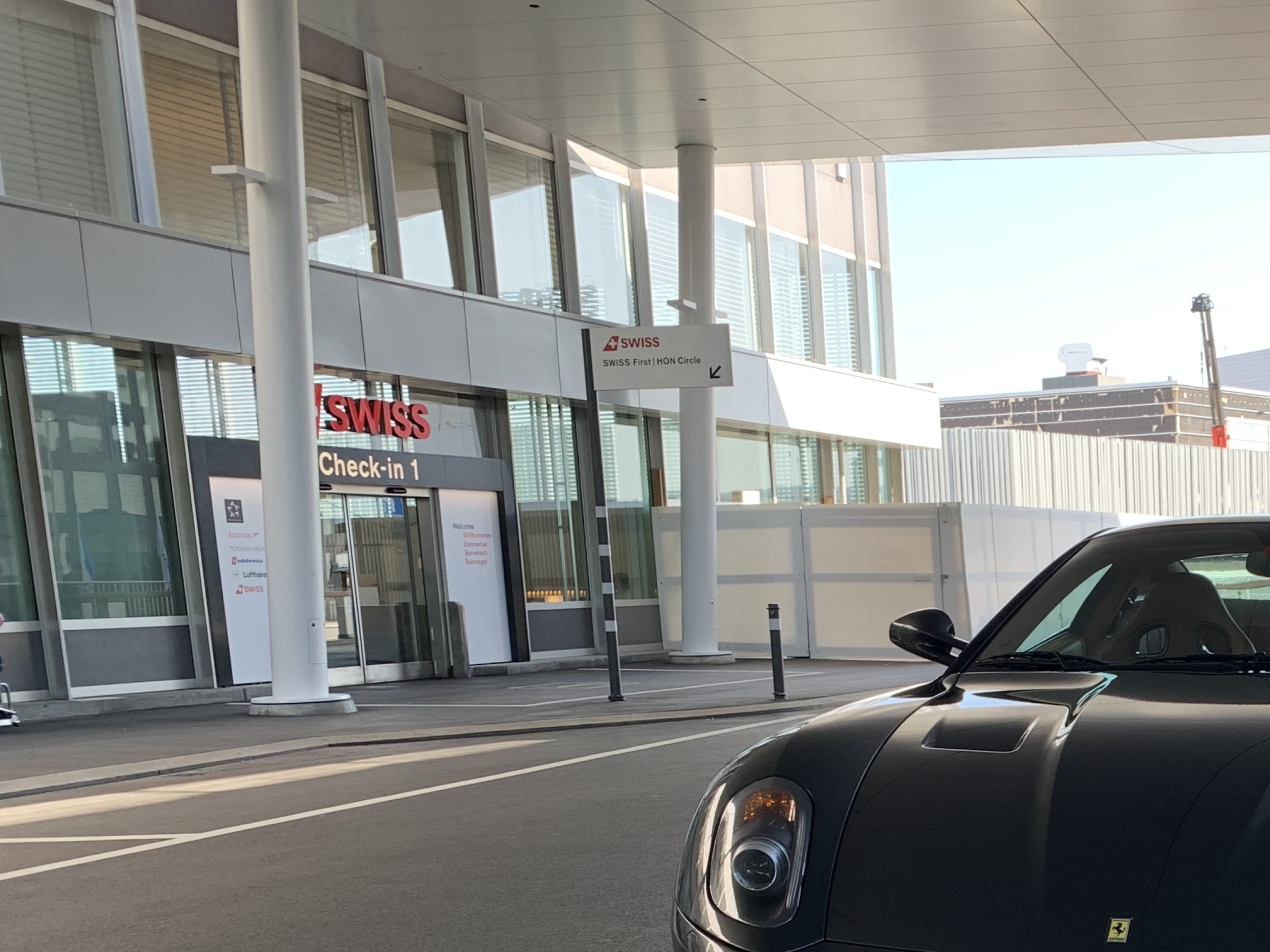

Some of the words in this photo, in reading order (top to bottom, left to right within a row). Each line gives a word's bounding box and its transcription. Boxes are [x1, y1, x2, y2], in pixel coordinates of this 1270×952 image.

[620, 337, 660, 349] SWISS
[603, 358, 631, 367] SWISS
[633, 358, 652, 366] First
[656, 357, 676, 365] HON
[677, 356, 701, 365] Circle
[326, 395, 431, 439] SWISS
[319, 451, 404, 480] Check-in
[410, 458, 419, 481] 1
[452, 522, 474, 530] Welcome
[243, 585, 264, 593] SWISS
